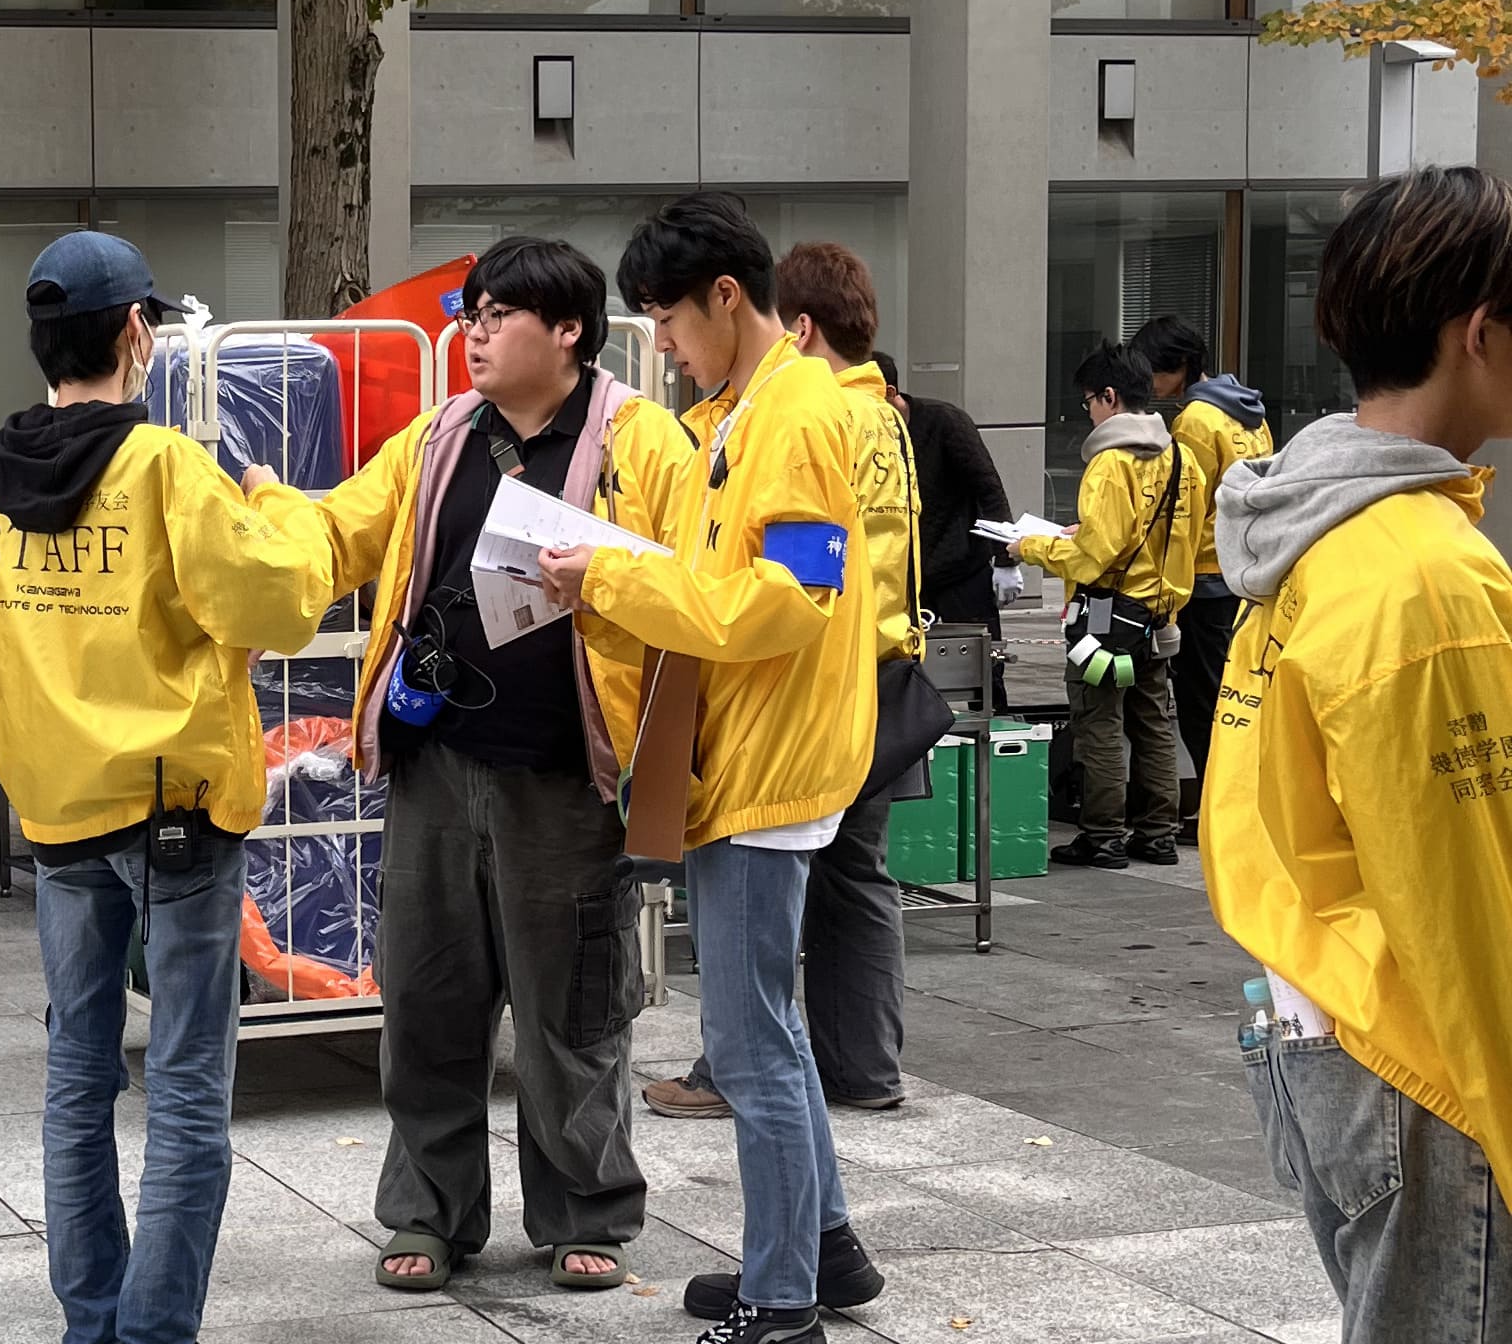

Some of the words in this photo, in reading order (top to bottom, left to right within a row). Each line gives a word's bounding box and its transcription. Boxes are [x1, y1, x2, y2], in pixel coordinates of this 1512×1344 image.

[35, 602, 54, 613] OF
[58, 605, 130, 616] TECHNOLOGY
[1221, 713, 1251, 729] OF
